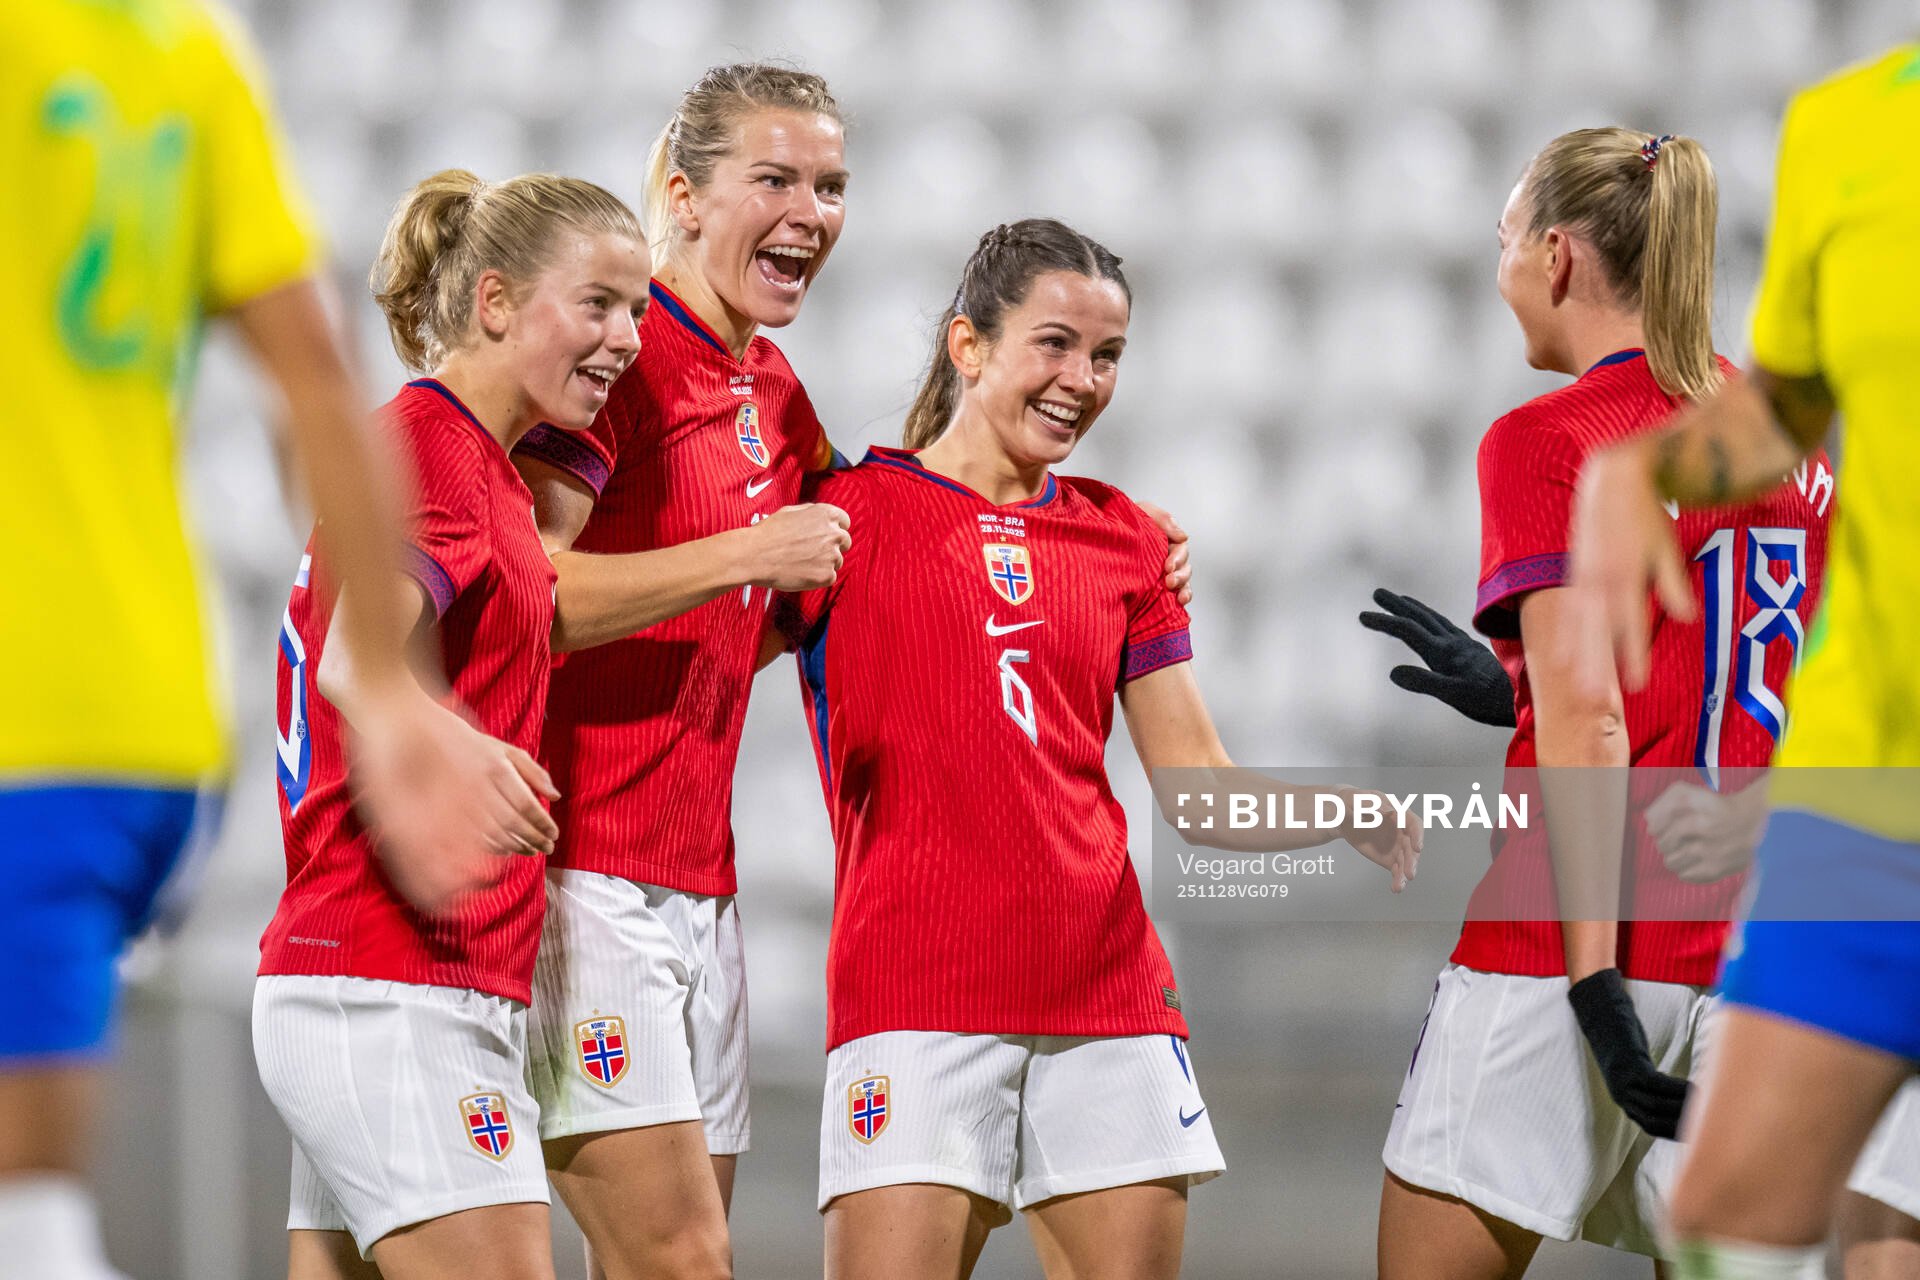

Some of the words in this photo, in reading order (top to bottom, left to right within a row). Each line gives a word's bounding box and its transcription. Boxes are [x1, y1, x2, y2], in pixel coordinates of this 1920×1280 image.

[978, 514, 997, 522] NOR
[1005, 517, 1025, 527] BRA
[981, 525, 1025, 537] 28.11.2025
[1694, 526, 1807, 792] 18
[998, 649, 1038, 747] 6
